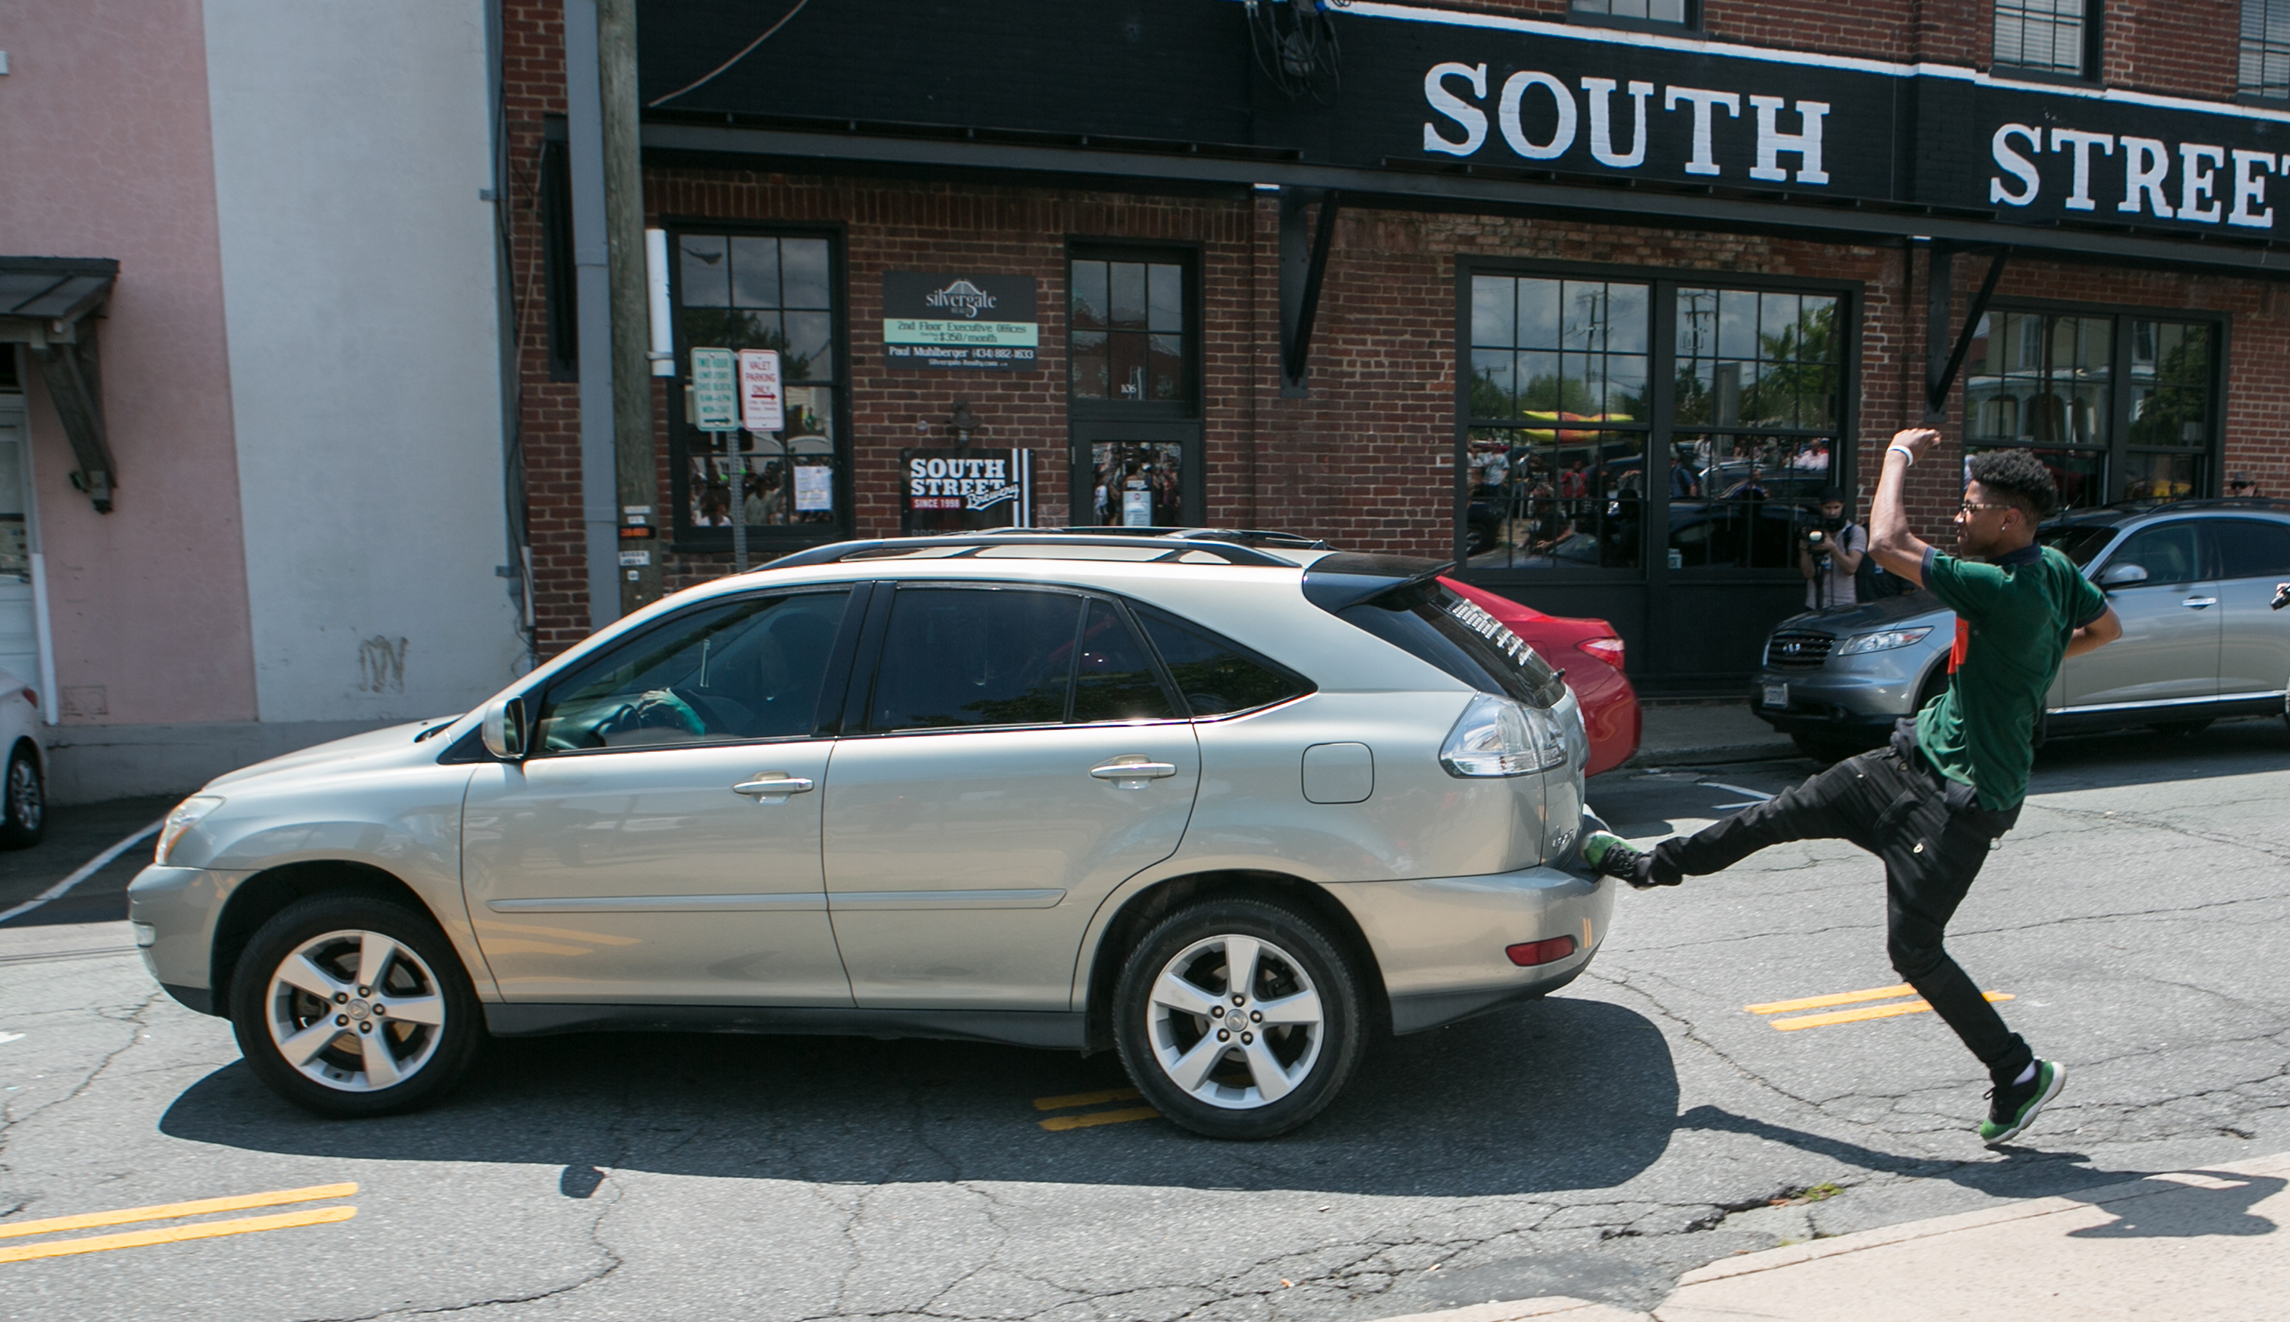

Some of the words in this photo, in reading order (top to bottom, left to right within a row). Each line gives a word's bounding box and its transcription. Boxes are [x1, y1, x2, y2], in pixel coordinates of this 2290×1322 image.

[1424, 62, 1830, 184] SOUTH
[1990, 123, 2290, 228] STREE
[926, 289, 997, 318] silvergate
[898, 321, 915, 330] 2nd
[919, 321, 943, 331] Floor
[947, 322, 993, 332] Executive
[997, 324, 1027, 333] Offices
[889, 346, 910, 356] Paul
[913, 347, 969, 359] Muhlberger
[749, 361, 771, 371] VALET
[746, 373, 776, 382] PARKING
[752, 384, 770, 394] ONLY
[910, 458, 1005, 478] SOUTH
[911, 479, 1005, 496] STREET
[965, 483, 1020, 508] Brewery
[914, 499, 938, 508] SINCE
[940, 499, 960, 508] 1998
